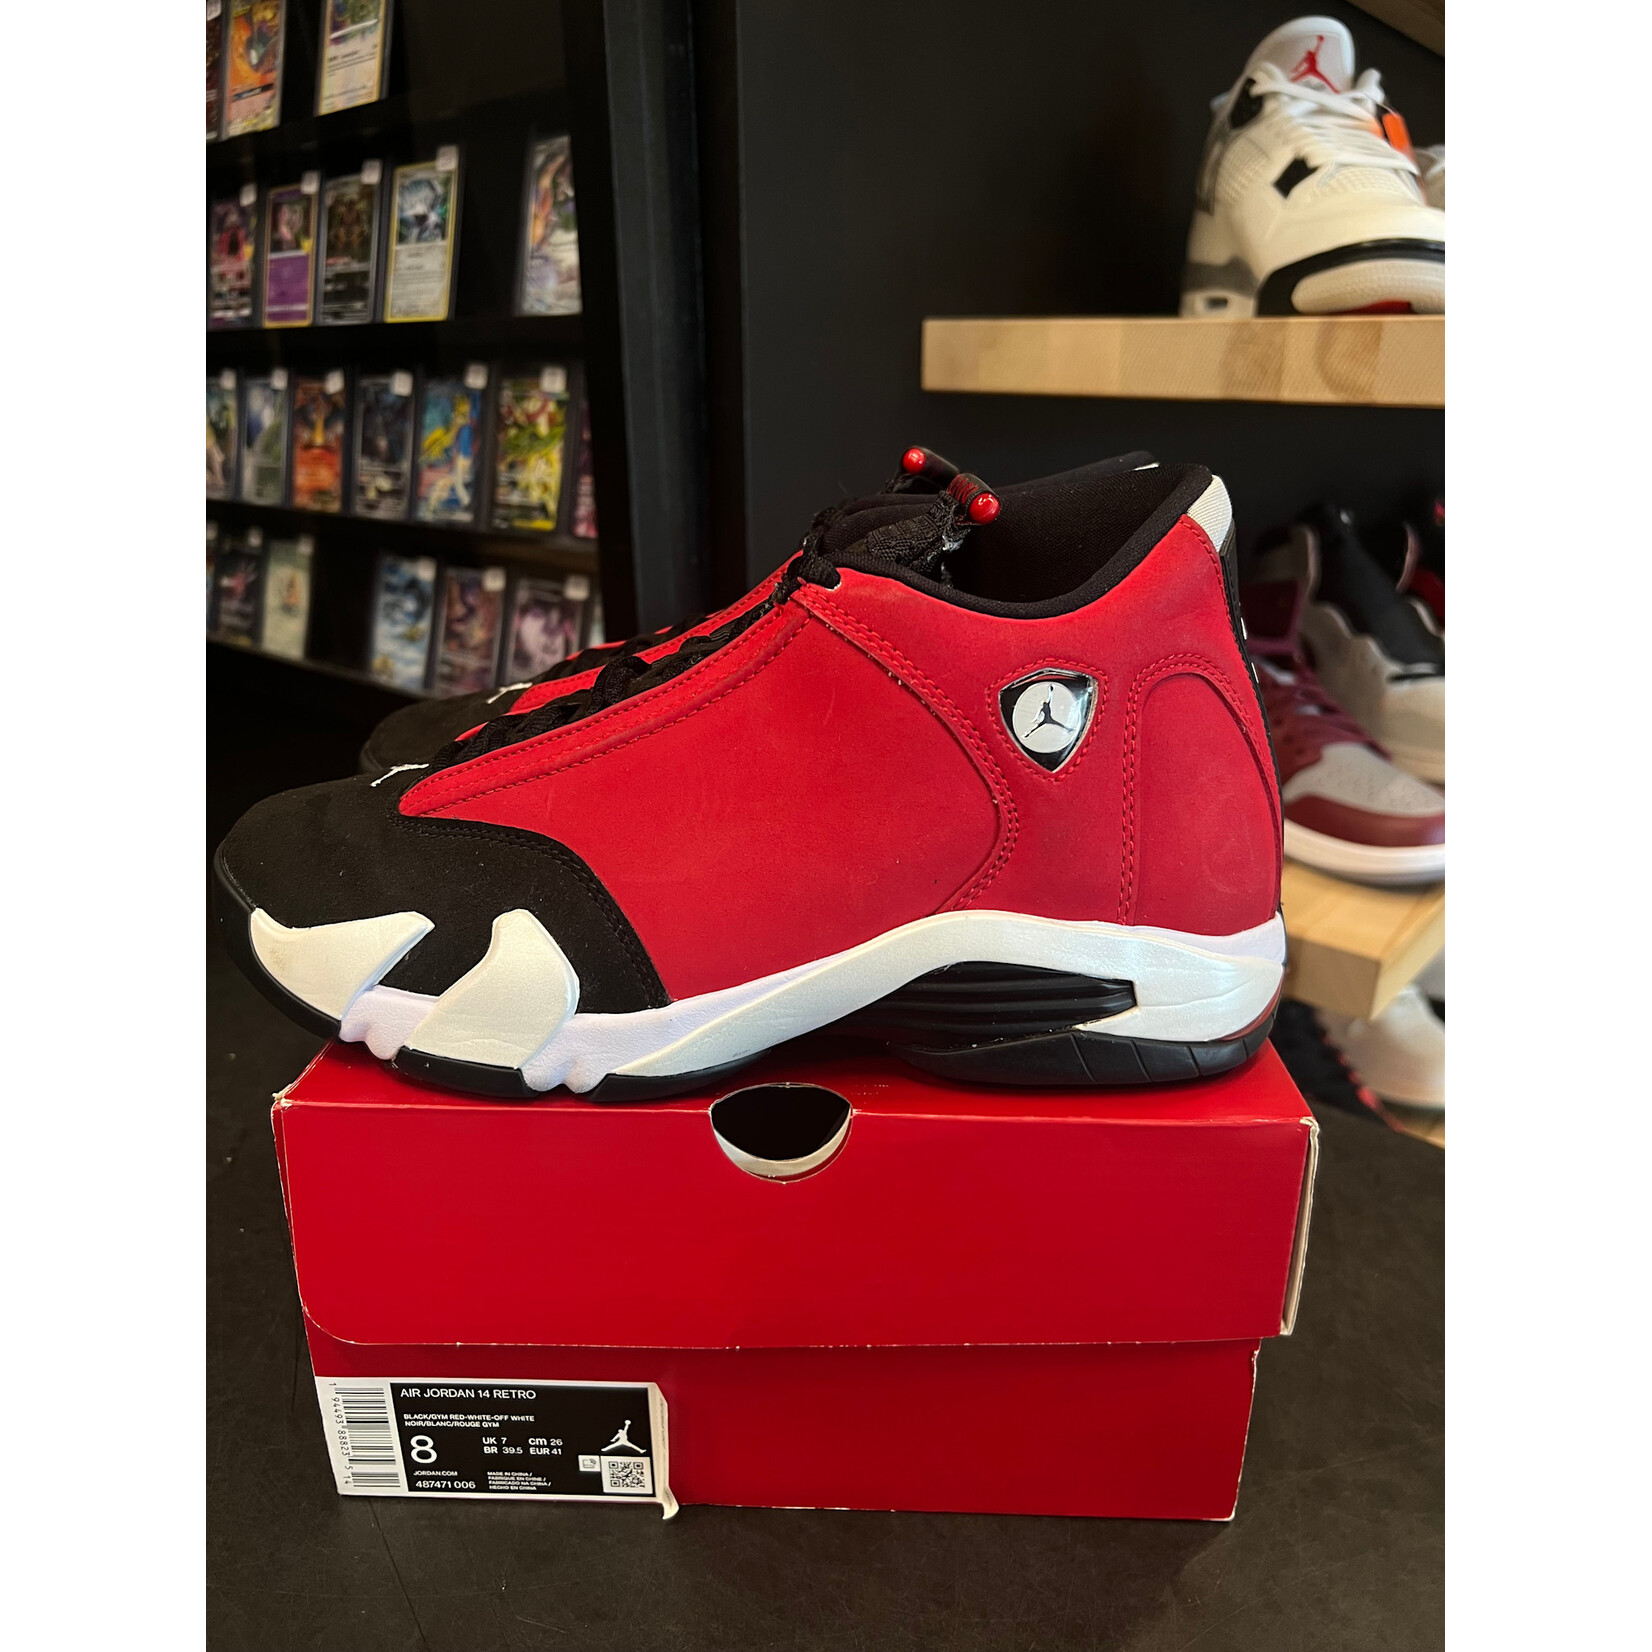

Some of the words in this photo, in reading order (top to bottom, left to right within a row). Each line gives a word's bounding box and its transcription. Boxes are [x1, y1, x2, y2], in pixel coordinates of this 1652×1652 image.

[400, 1388, 421, 1398] AIR
[423, 1388, 475, 1399] JORDAN
[477, 1389, 491, 1399] 14
[493, 1389, 537, 1400] RETRO
[403, 1413, 448, 1421] BLACK/GYM
[449, 1414, 509, 1422] RED-WHITE-OFF
[332, 1397, 343, 1424] 94493
[338, 1430, 350, 1456] 88823
[482, 1436, 497, 1445] UK
[500, 1437, 508, 1445] 7
[528, 1437, 548, 1446] cm
[550, 1438, 563, 1446] 26
[410, 1434, 438, 1464] 8
[483, 1446, 499, 1454] BR
[502, 1447, 523, 1455] 39.5
[529, 1447, 550, 1455] EUR
[551, 1448, 562, 1456] 41
[415, 1480, 452, 1489] 487471
[453, 1481, 476, 1490] 006
